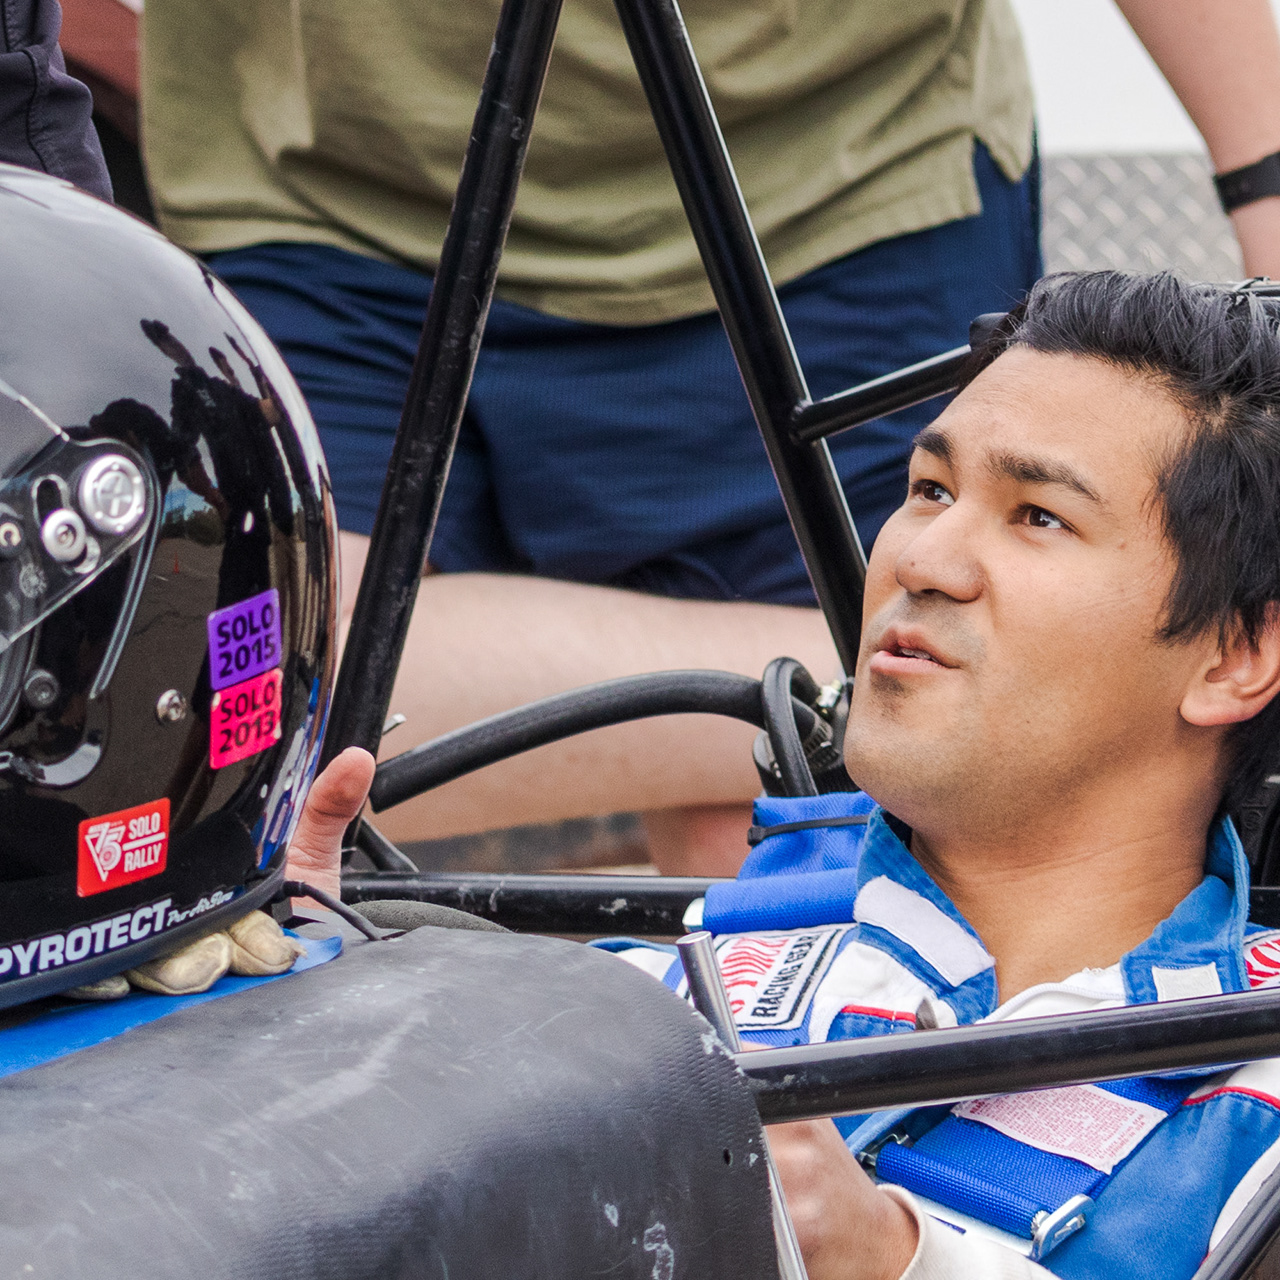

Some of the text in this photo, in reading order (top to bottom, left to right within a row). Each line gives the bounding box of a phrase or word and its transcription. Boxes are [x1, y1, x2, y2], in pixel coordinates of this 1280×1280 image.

[217, 603, 274, 649] SOLO
[218, 633, 276, 678] 2015
[220, 681, 276, 723] SOLO
[219, 710, 276, 754] 2013
[128, 812, 161, 840] SOLO
[123, 842, 162, 873] RALLY
[751, 935, 821, 1017] RACING GEAR
